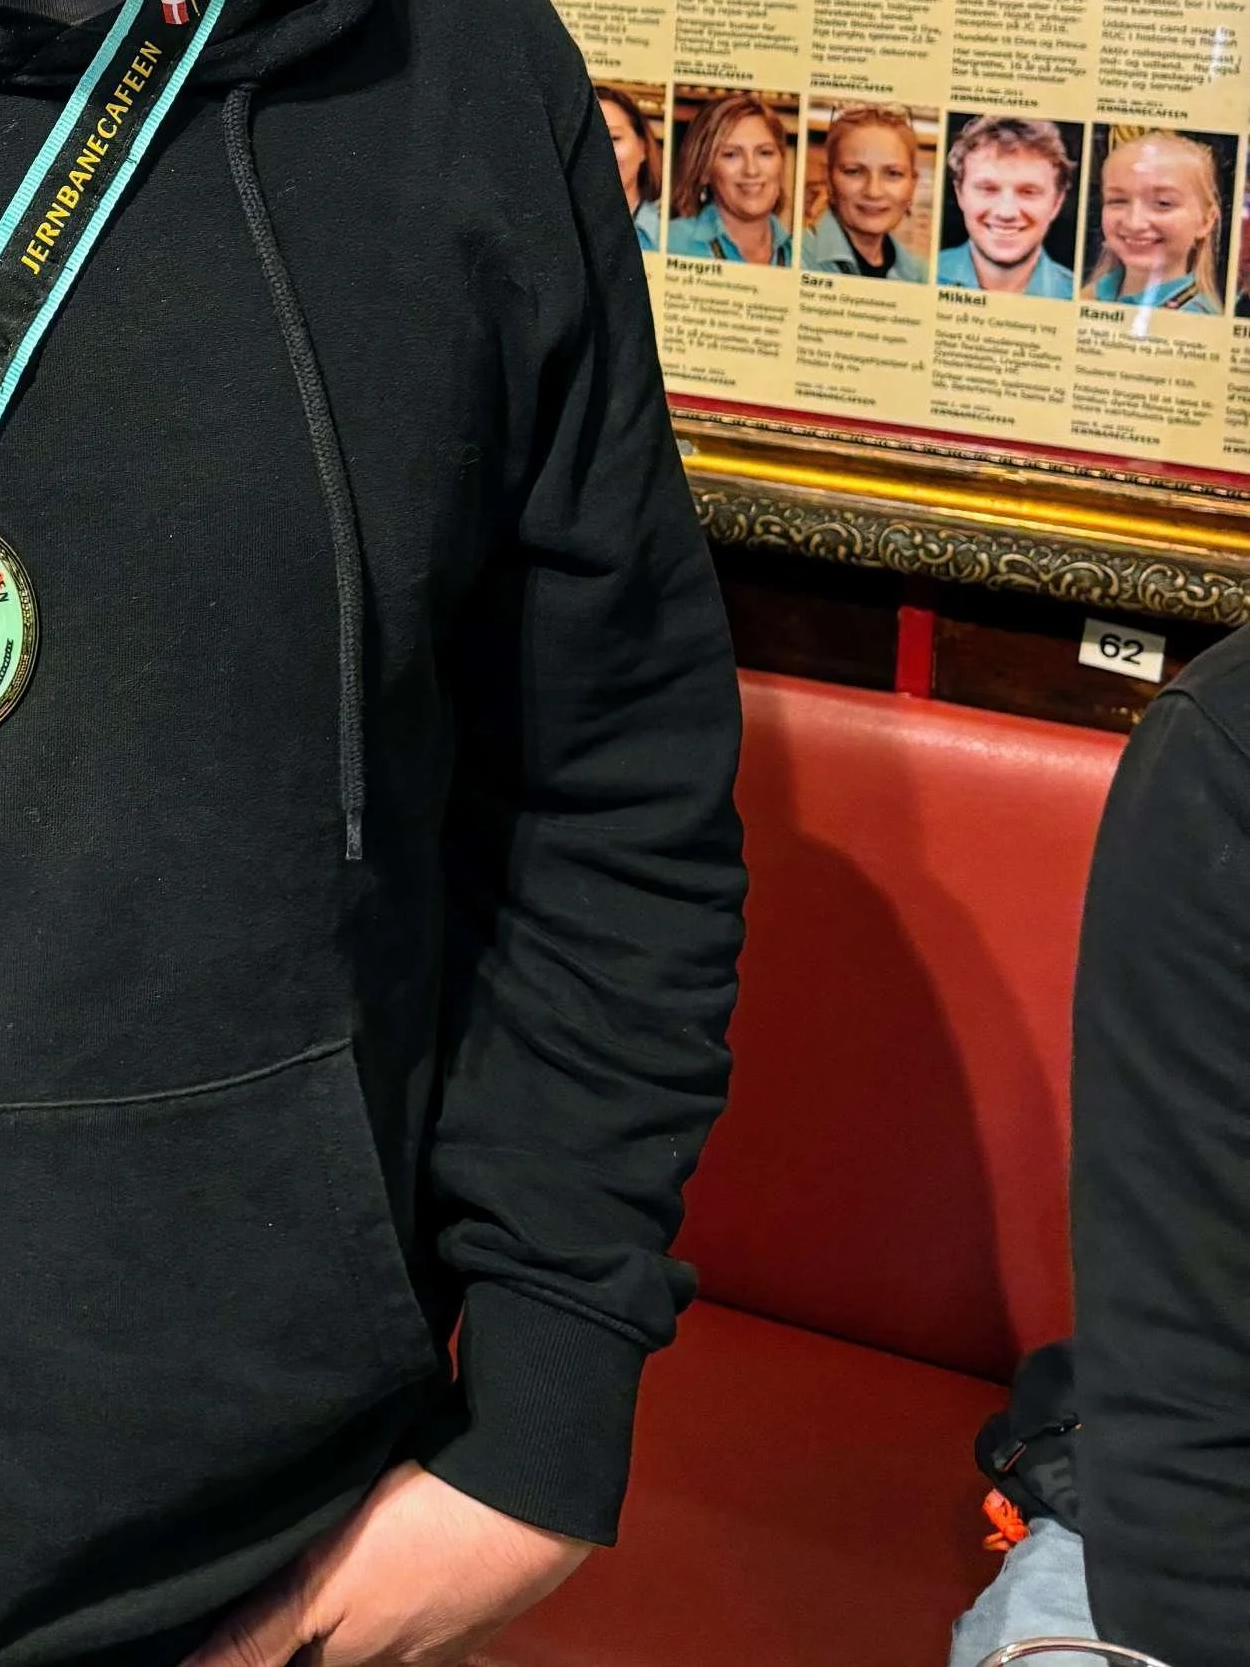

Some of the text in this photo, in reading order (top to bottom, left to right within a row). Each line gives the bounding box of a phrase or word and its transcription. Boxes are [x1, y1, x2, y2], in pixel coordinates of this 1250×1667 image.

[19, 39, 164, 276] JERNBANECAFEEN
[666, 257, 722, 274] Margrit
[801, 273, 833, 288] Sara
[939, 290, 986, 306] Mikkel
[1080, 306, 1125, 322] Randi
[1099, 632, 1145, 666] 62
